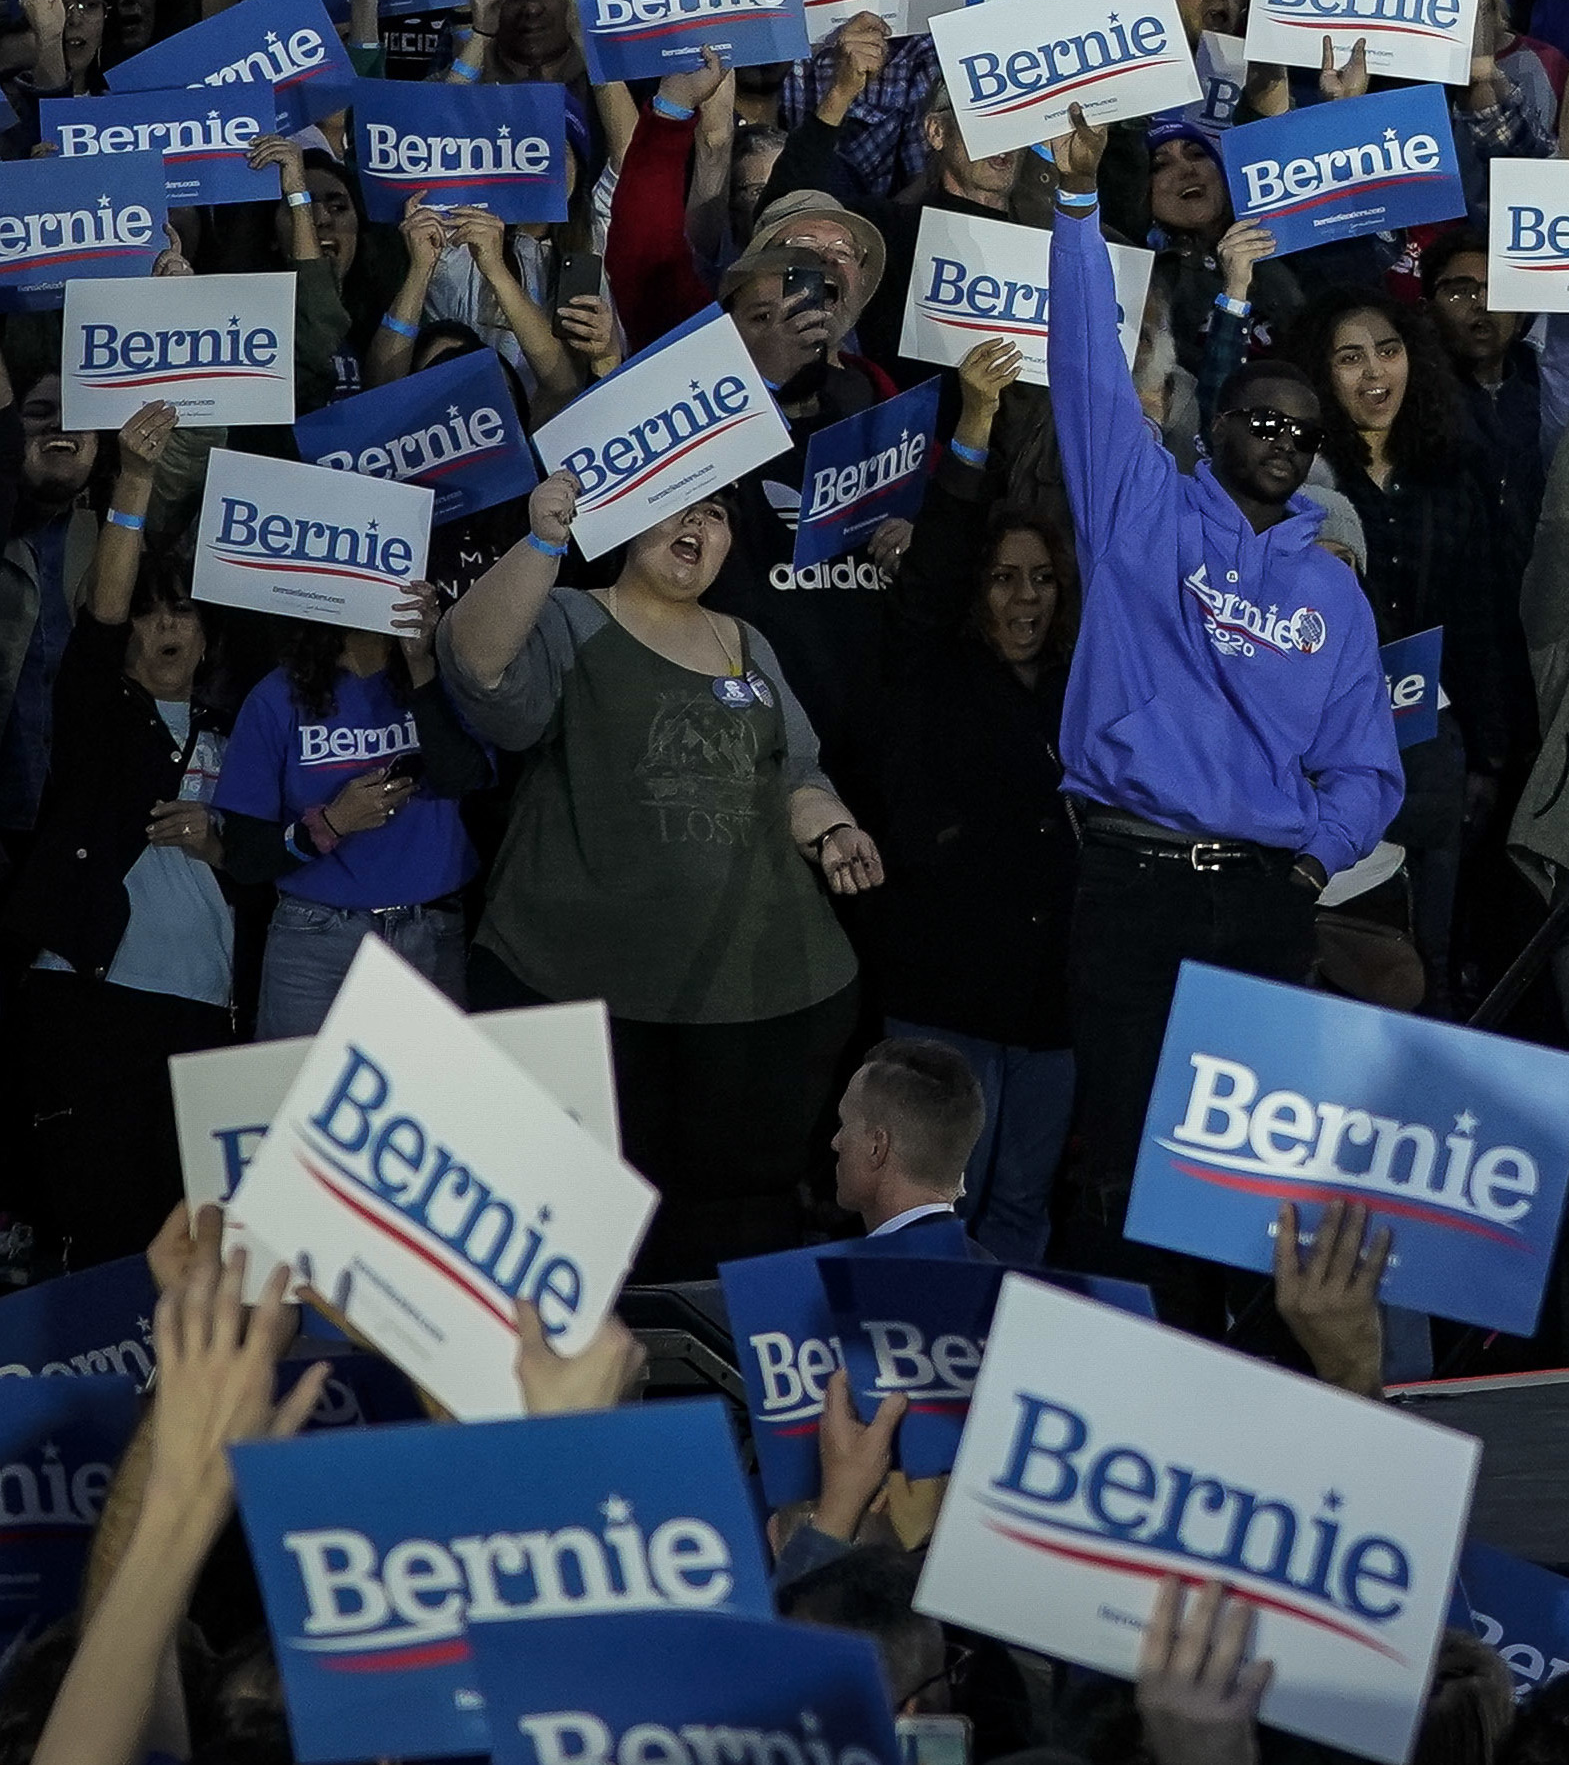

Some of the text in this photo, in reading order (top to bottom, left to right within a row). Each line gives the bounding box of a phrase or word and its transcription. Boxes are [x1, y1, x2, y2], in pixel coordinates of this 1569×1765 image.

[959, 11, 1168, 104] Bernie
[57, 110, 260, 158] Bernie
[368, 125, 550, 174] Bernie
[1242, 127, 1441, 207] Bernie
[0, 195, 153, 255] ernie
[80, 315, 277, 372] Bernie
[561, 374, 750, 494] Bernie
[809, 429, 925, 516] Bernie
[220, 497, 413, 576] Bernie
[1204, 616, 1255, 657] 2020
[300, 711, 420, 765] Berni
[1173, 1053, 1538, 1226] Bernie
[309, 1046, 585, 1338] Bernie
[991, 1393, 1412, 1624] Bernie
[284, 1495, 733, 1635] Bernie
